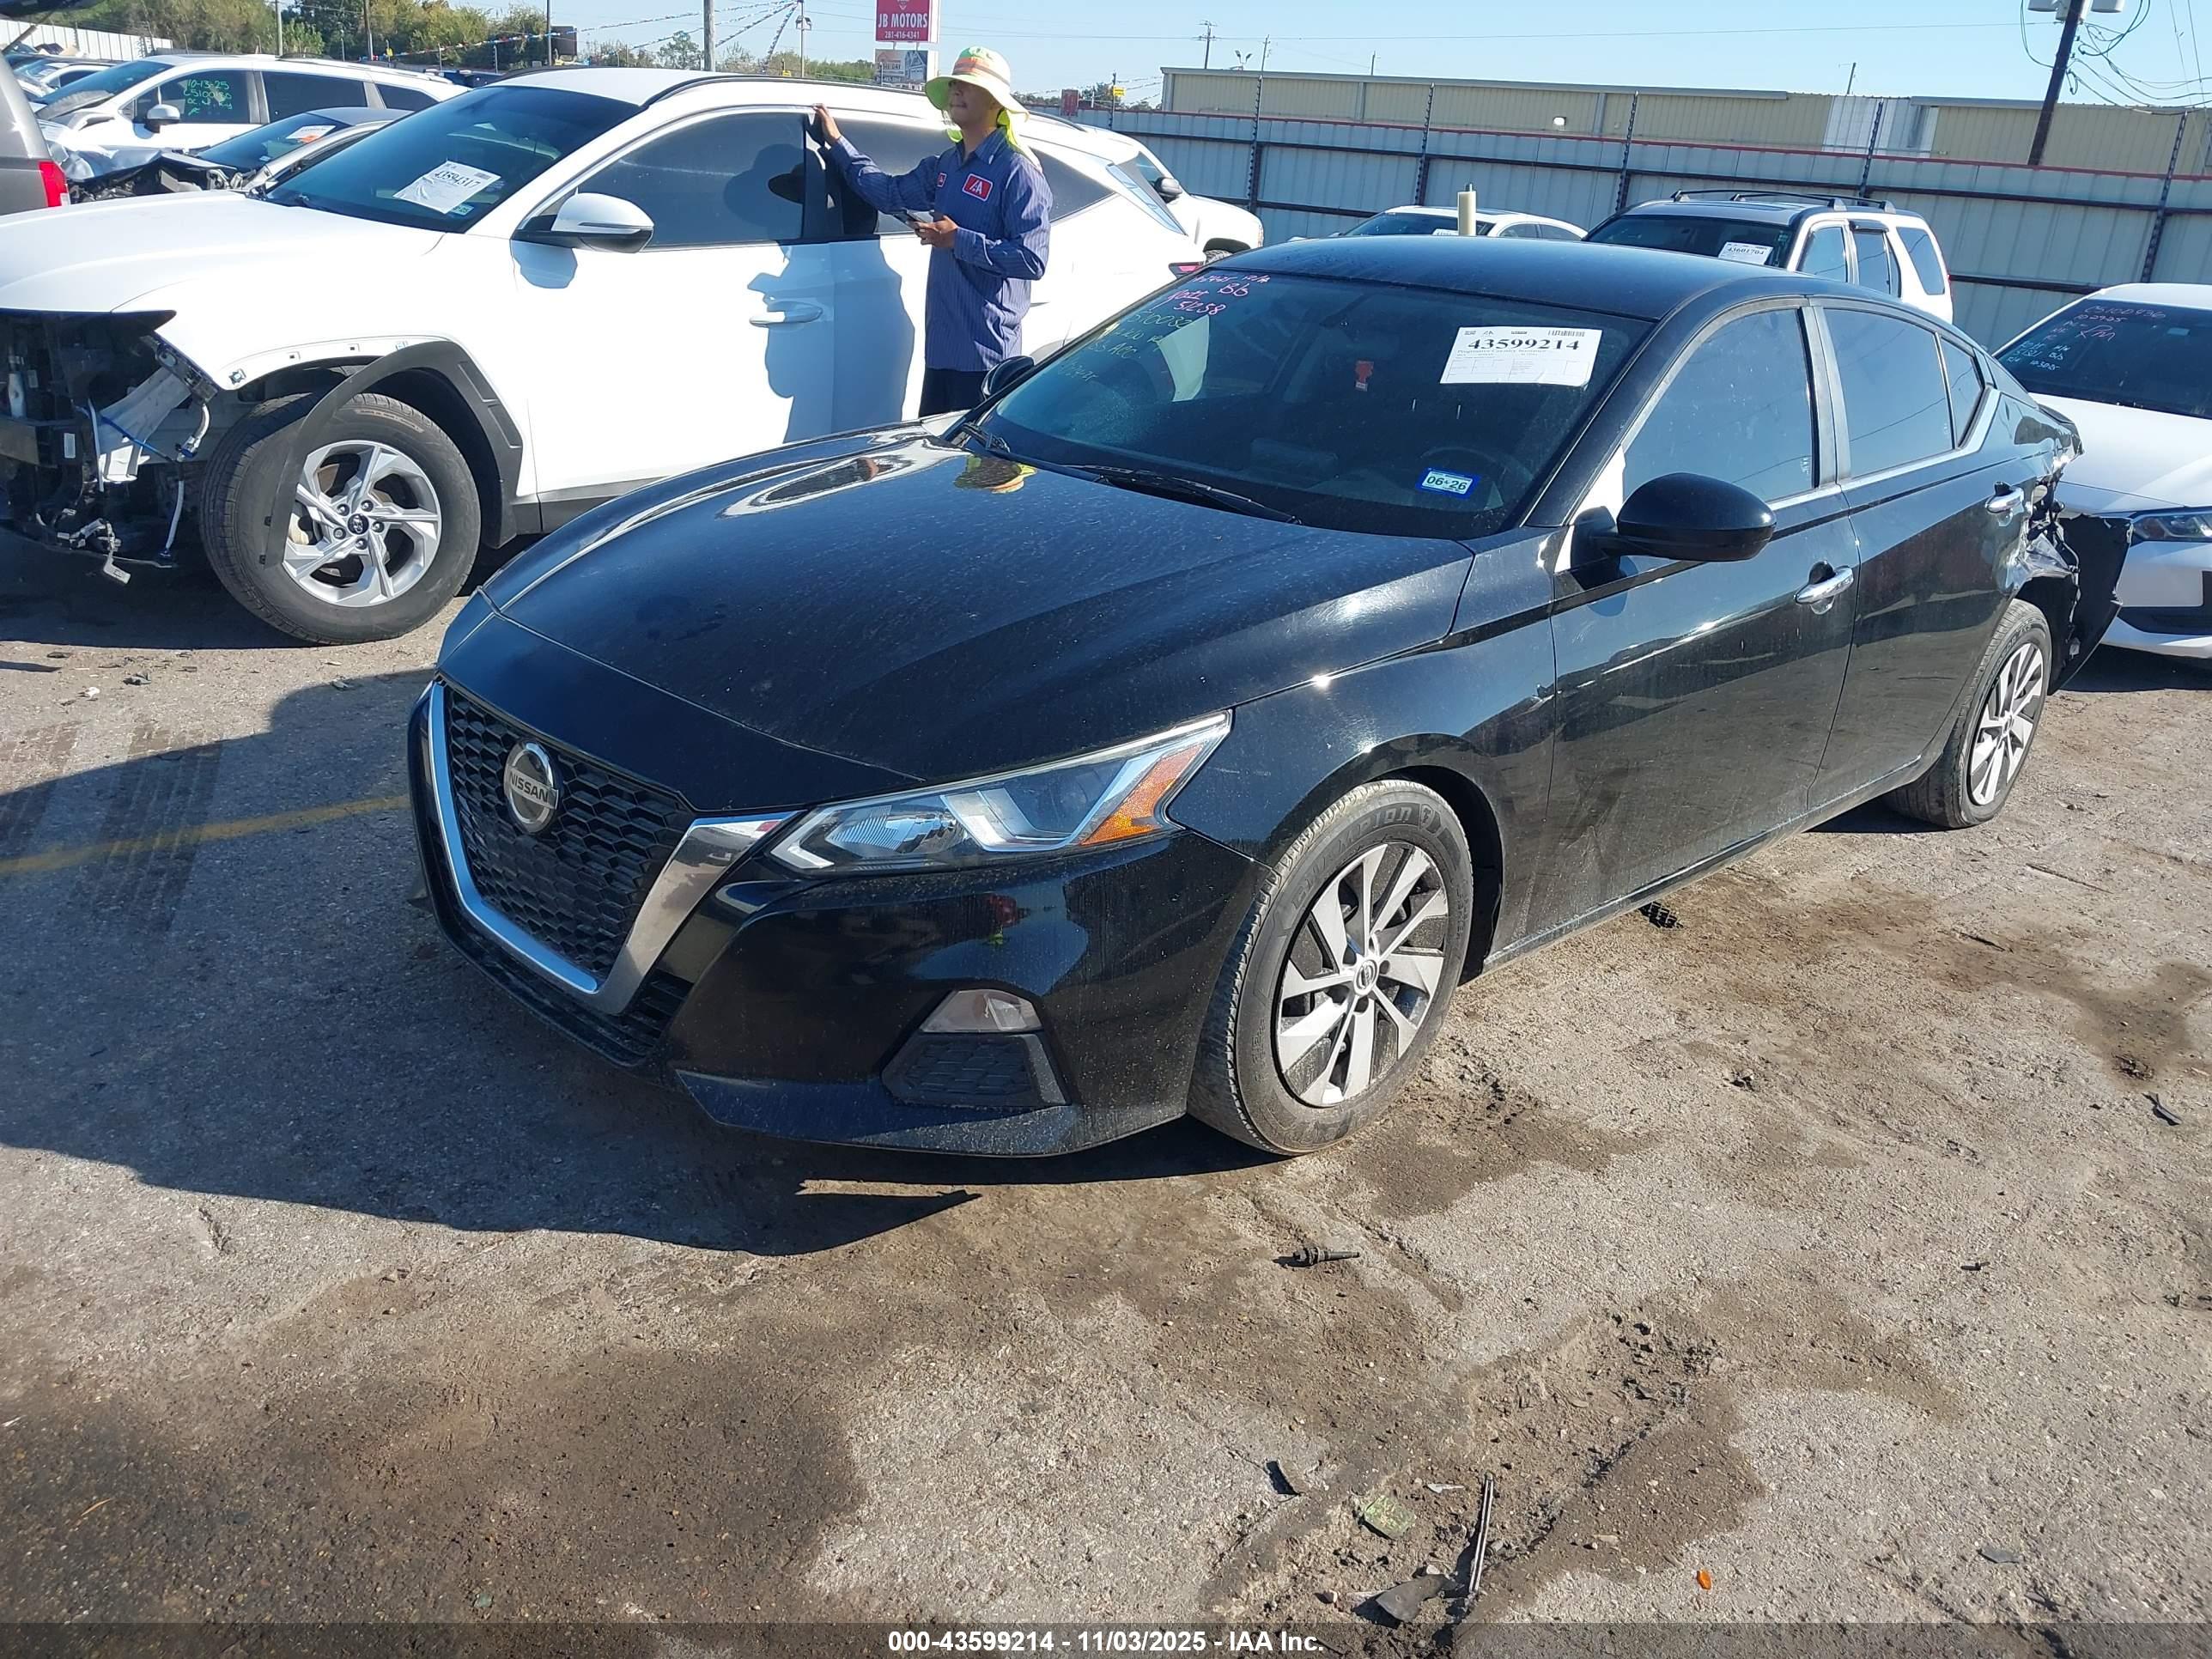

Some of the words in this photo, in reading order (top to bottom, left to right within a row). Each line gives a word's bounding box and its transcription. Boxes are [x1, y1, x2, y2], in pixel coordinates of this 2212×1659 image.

[878, 13, 888, 28] JB
[891, 13, 928, 28] MOTORS
[884, 30, 920, 40] 281-416-4341
[1468, 338, 1580, 350] 43599214
[510, 771, 549, 803] NISSAN
